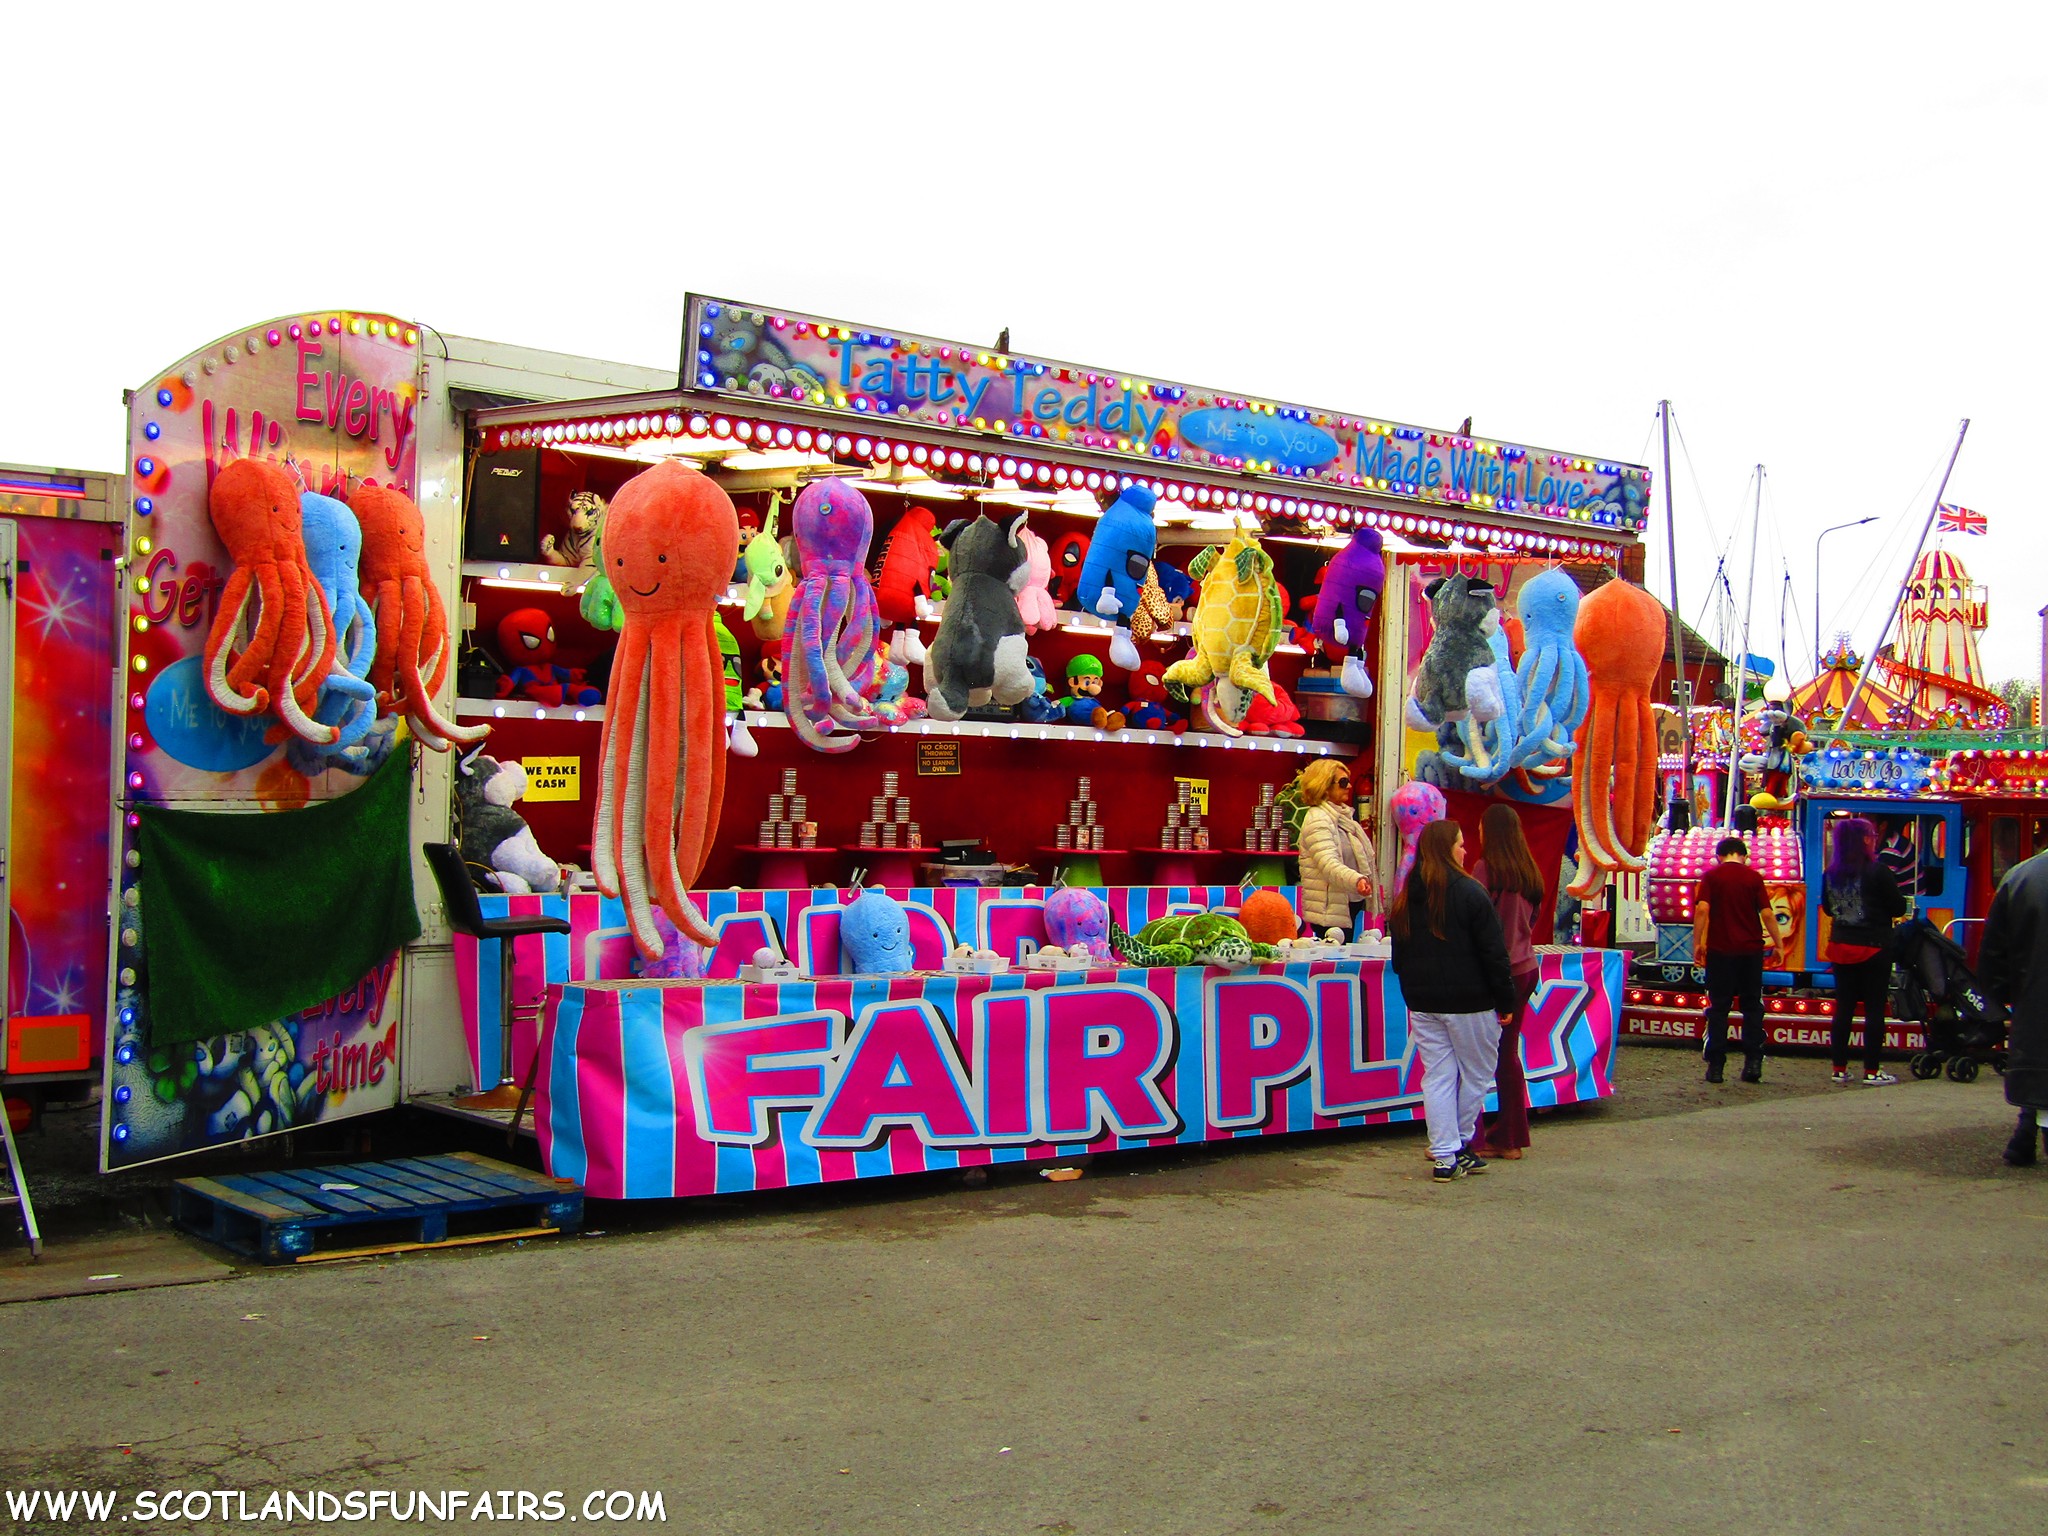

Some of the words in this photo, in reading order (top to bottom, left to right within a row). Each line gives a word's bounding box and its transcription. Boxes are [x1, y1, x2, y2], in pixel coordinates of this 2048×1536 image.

[828, 337, 990, 418] Tatty
[1003, 367, 1166, 444] Teddy
[295, 336, 411, 469] Every
[1356, 431, 1442, 487] Made
[1450, 446, 1519, 501] With
[1525, 460, 1584, 508] Love
[525, 766, 542, 776] WE
[546, 766, 577, 775] TAKE
[1832, 760, 1855, 779] Let
[1880, 760, 1902, 783] Go
[535, 779, 567, 788] CASH
[1191, 787, 1207, 795] AKE
[1190, 796, 1200, 804] SH
[1962, 988, 1984, 1011] Joie
[1629, 1018, 1696, 1037] PLEASE
[312, 1030, 386, 1095] time
[683, 983, 1183, 1148] FAIR
[1206, 974, 1592, 1130] PLY
